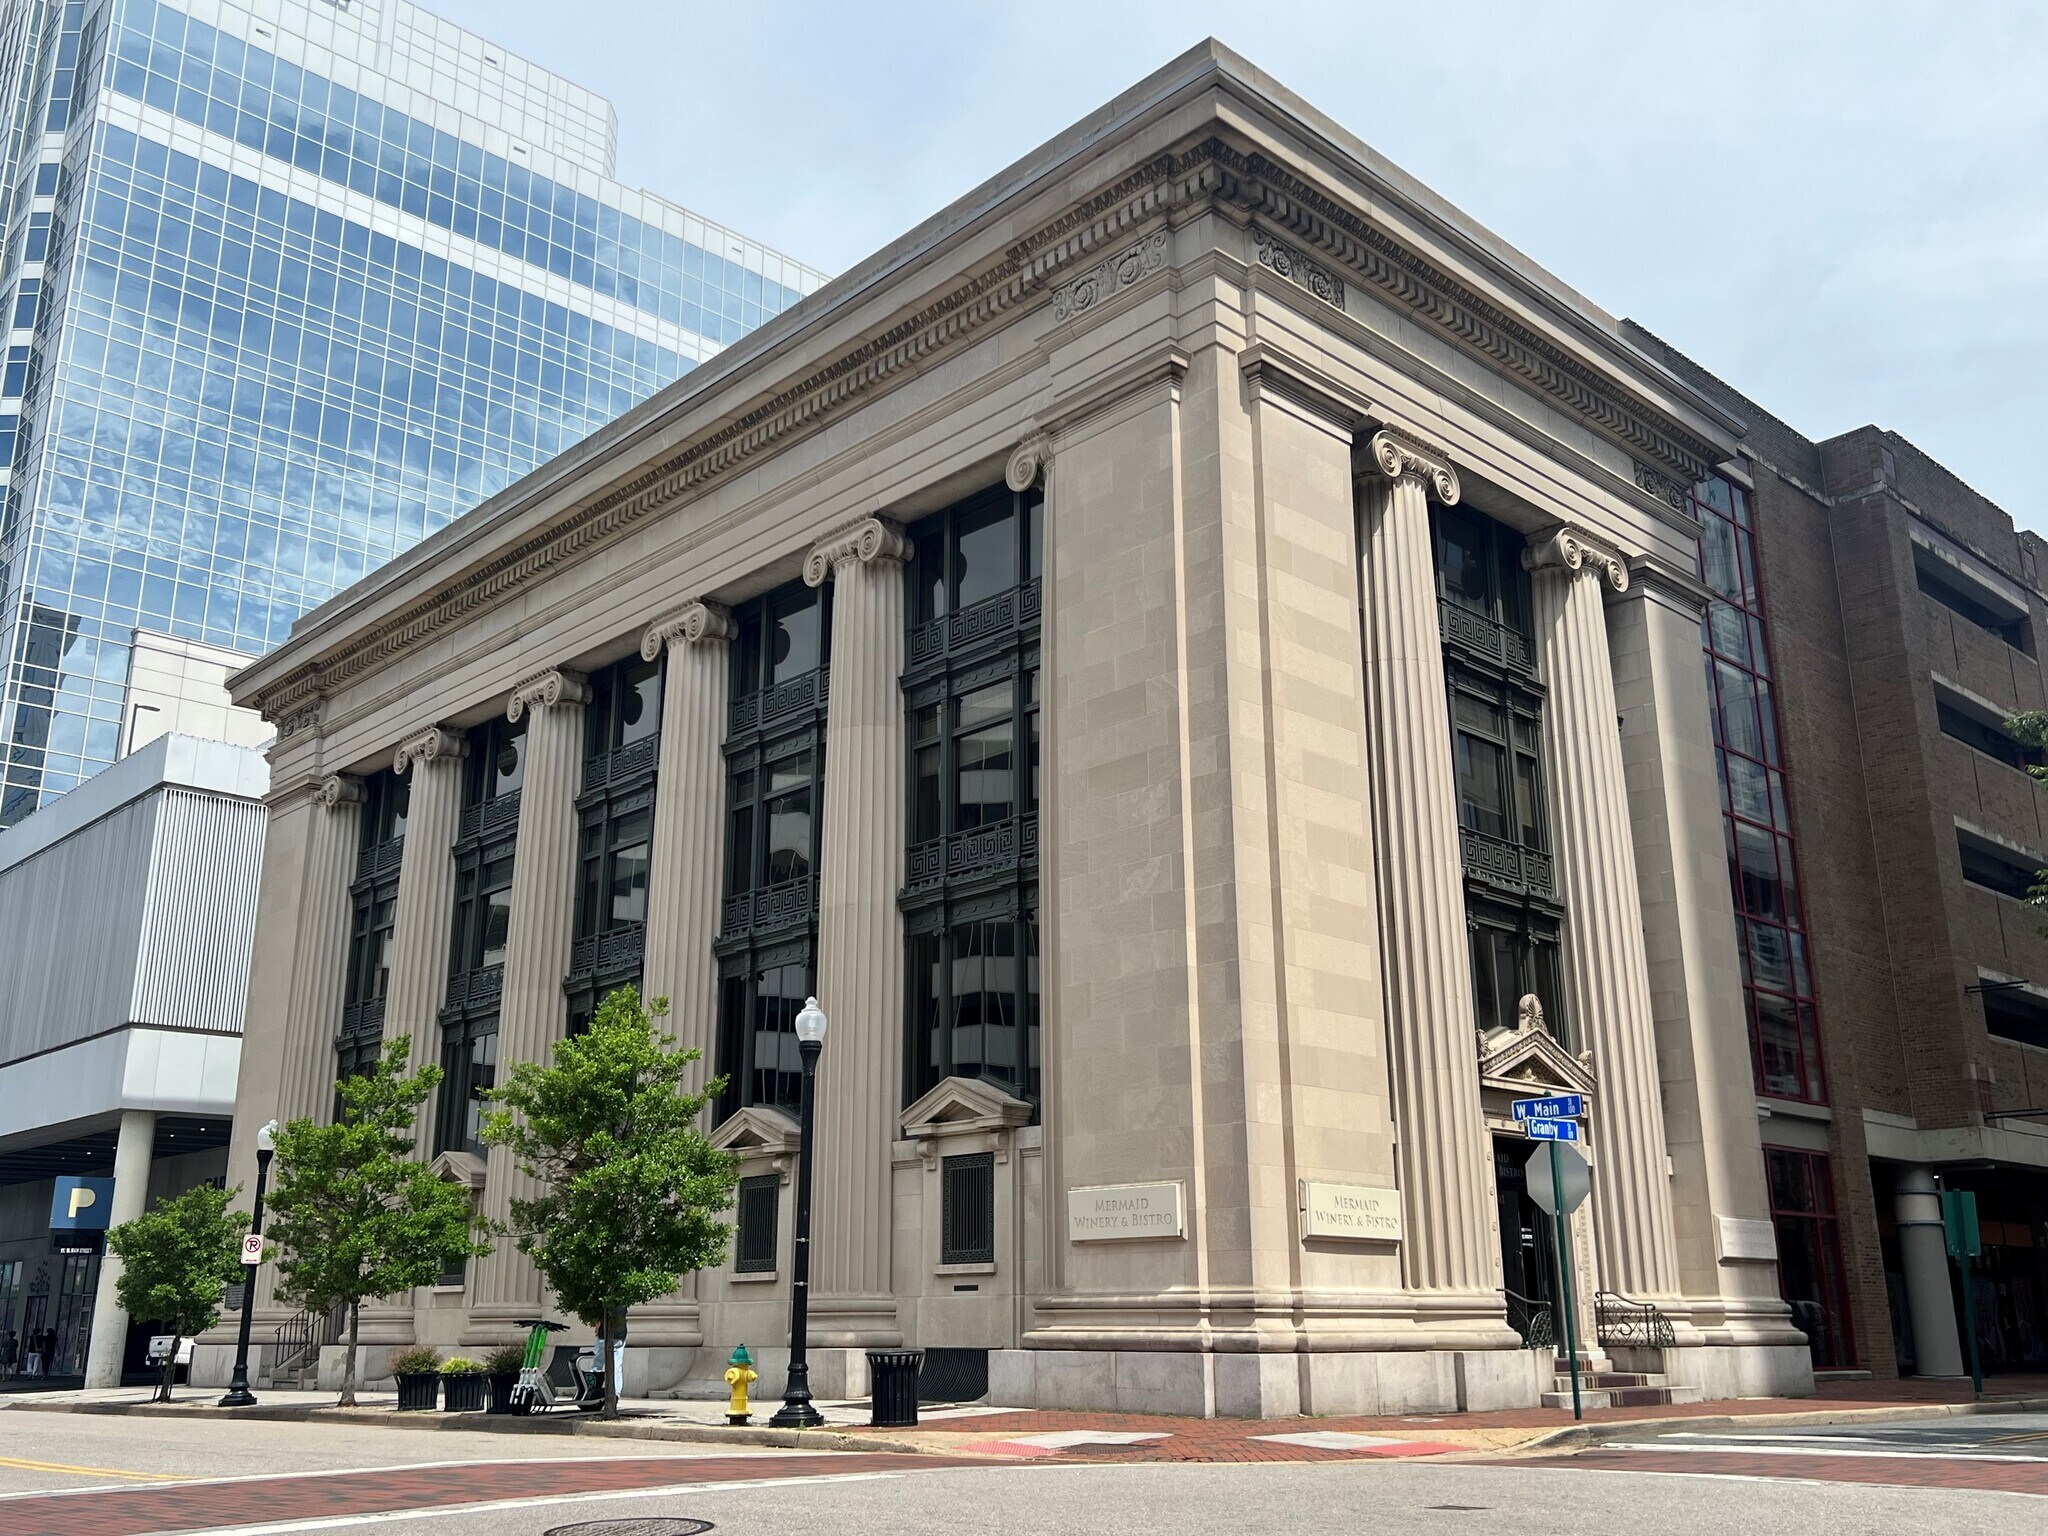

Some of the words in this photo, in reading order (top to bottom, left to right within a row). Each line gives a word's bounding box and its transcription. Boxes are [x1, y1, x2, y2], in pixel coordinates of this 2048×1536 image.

[1516, 1104, 1526, 1119] W
[1533, 1101, 1560, 1117] Main
[1531, 1119, 1558, 1139] Granby
[67, 1187, 96, 1218] P
[1095, 1197, 1149, 1212] MERMAID
[1334, 1195, 1380, 1211] MERMAID
[1074, 1216, 1118, 1229] WINERY
[1121, 1216, 1128, 1227] &
[1132, 1213, 1173, 1227] BISTRO
[1315, 1210, 1354, 1226] WINERY
[1357, 1215, 1364, 1227] &
[1366, 1214, 1398, 1229] BISTRO
